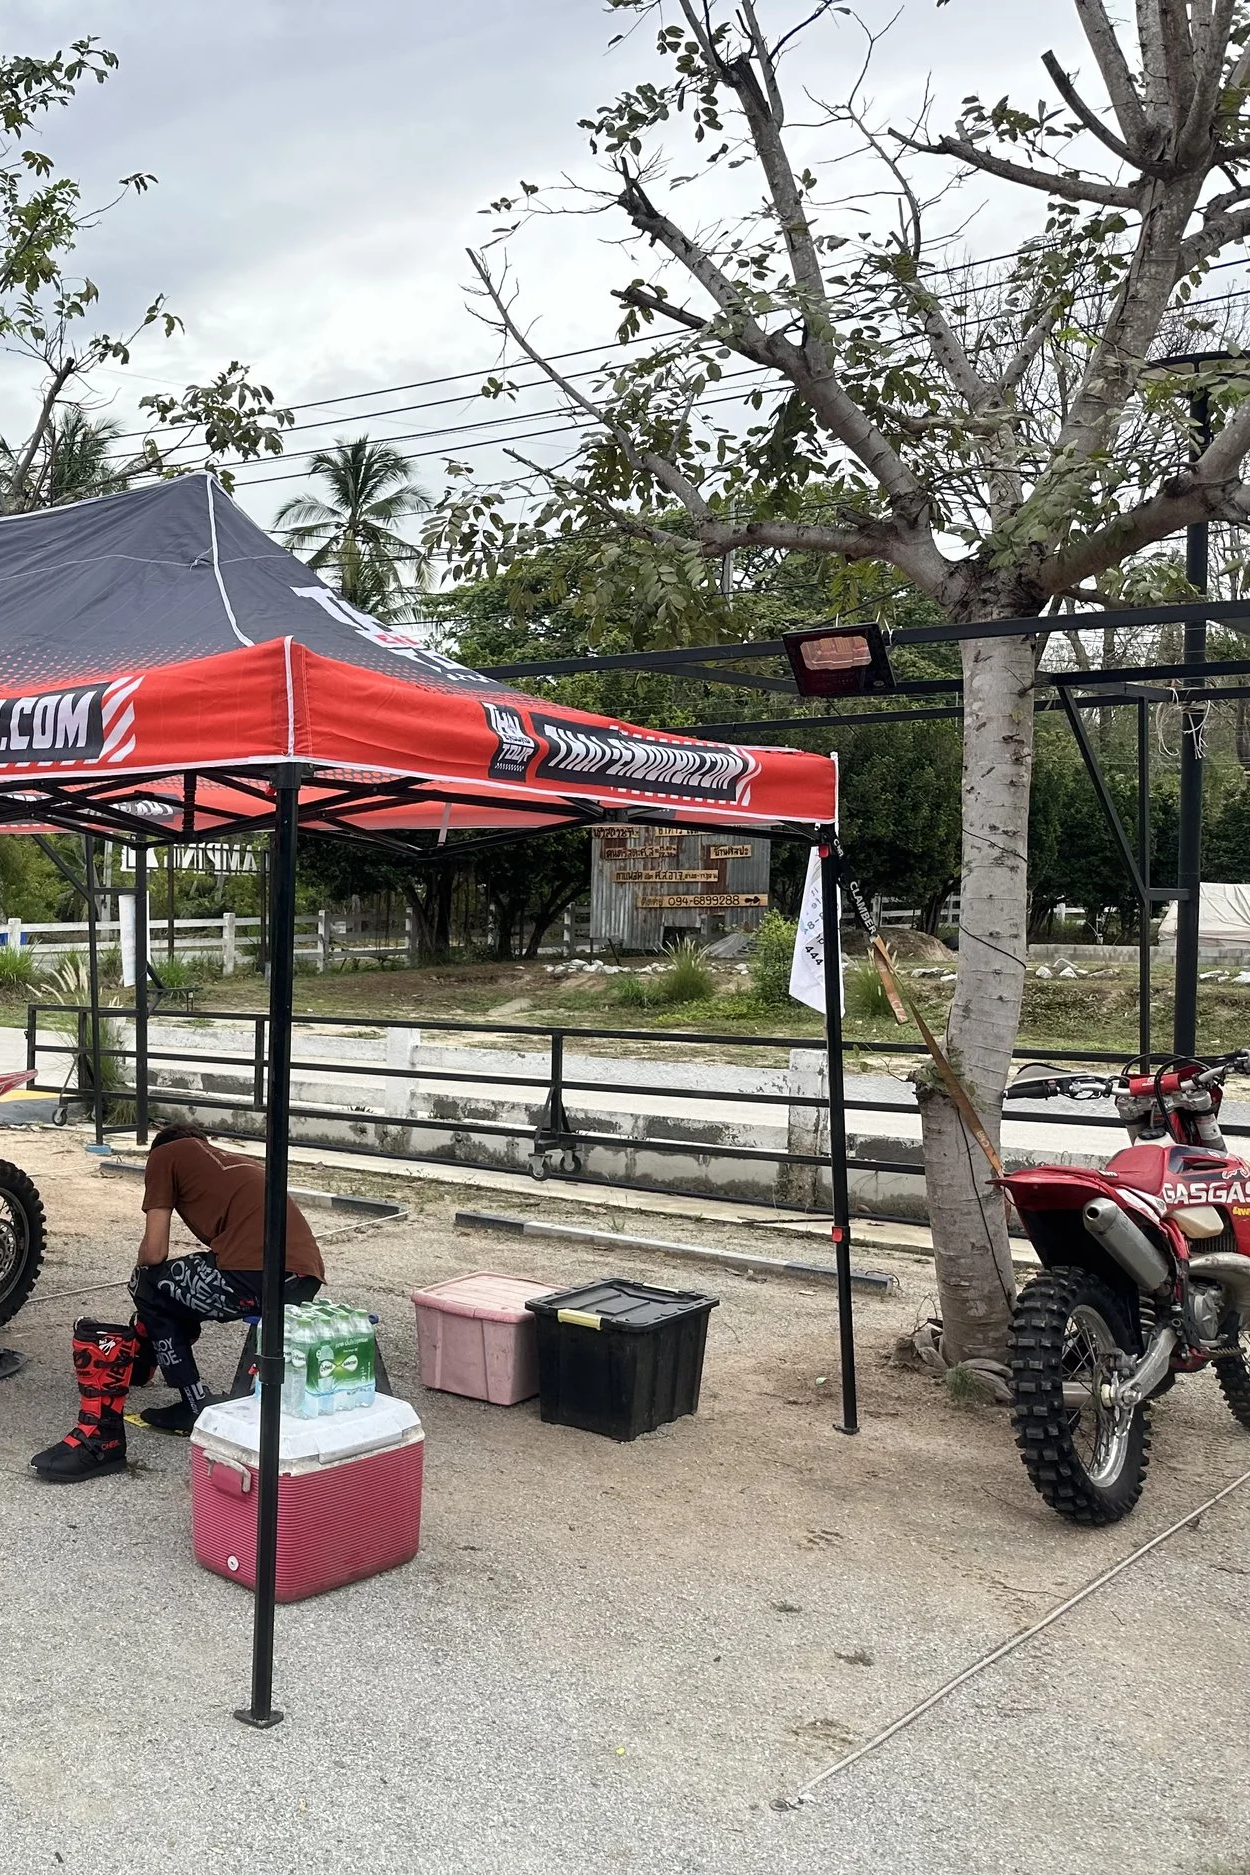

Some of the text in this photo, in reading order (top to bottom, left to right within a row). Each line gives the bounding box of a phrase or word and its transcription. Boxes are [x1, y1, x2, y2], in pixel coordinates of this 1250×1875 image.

[482, 702, 527, 737] THAI
[498, 743, 535, 762] TOUR
[544, 724, 744, 790] THAI-ENDURO.COM
[668, 894, 740, 907] 094-6899288
[849, 880, 878, 935] CLAMBER
